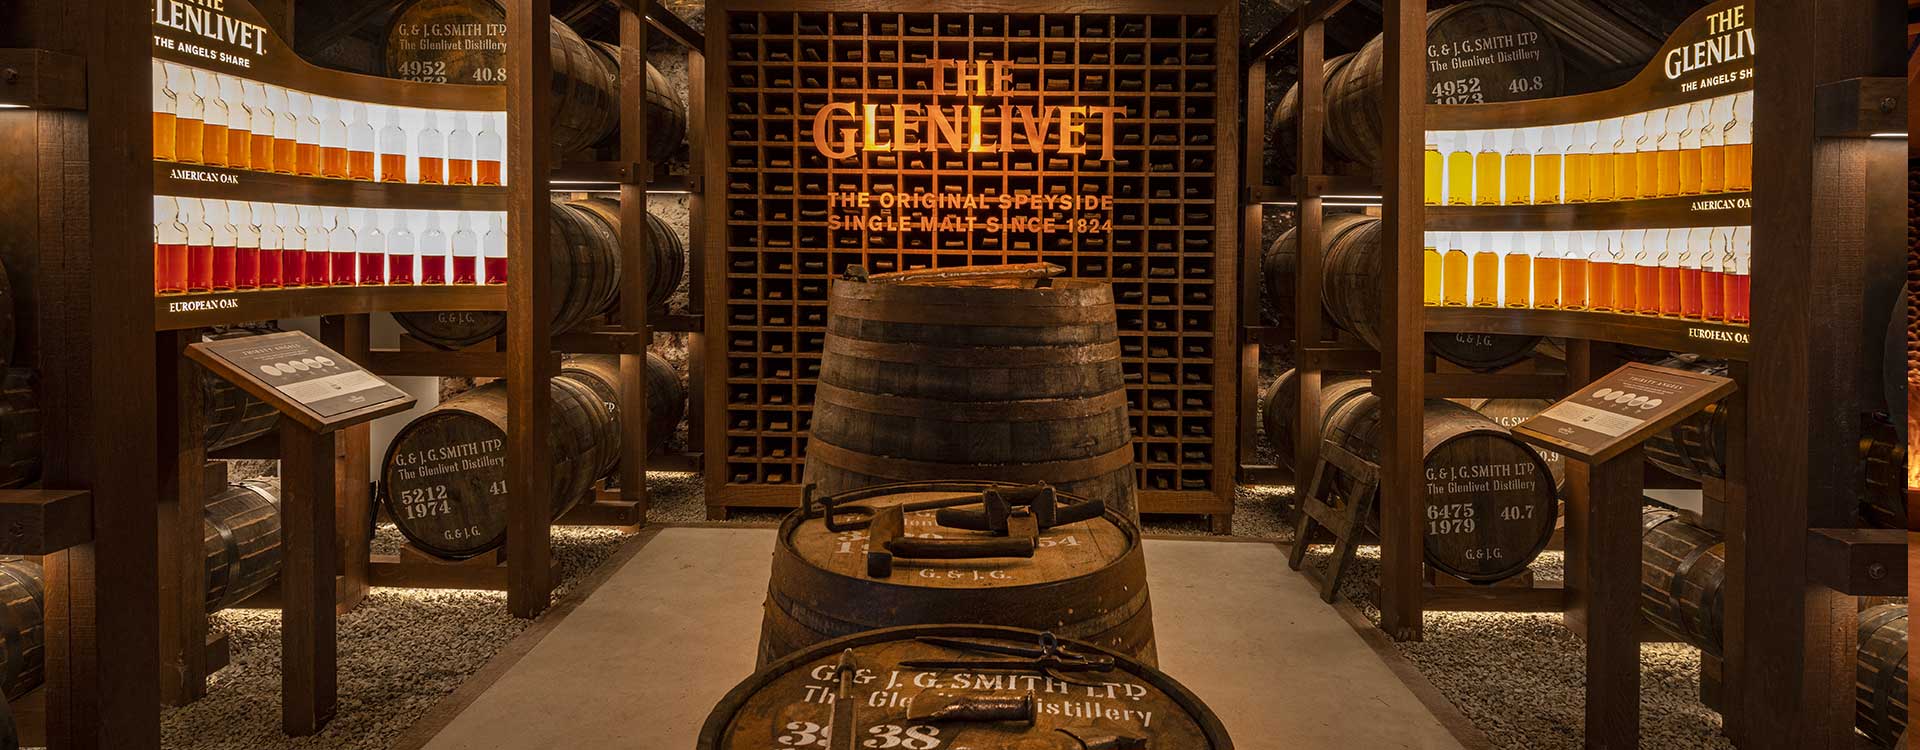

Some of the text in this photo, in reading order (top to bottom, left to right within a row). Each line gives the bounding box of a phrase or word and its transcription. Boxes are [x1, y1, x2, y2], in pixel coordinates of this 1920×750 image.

[1706, 5, 1744, 35] THE
[411, 24, 419, 35] &
[444, 24, 481, 36] SMITH
[154, 36, 174, 50] THE
[220, 53, 250, 68] SHARE
[399, 39, 507, 53] The Glenlivet Distillery
[1441, 44, 1450, 55] &
[1475, 35, 1513, 51] SMITH
[1430, 49, 1540, 72] The Glenlivet Distillery
[1665, 28, 1755, 80] GLENLIV
[398, 61, 446, 76] 4952
[472, 67, 507, 82] 40.8
[925, 59, 1014, 97] THE
[1509, 76, 1543, 93] 40.8
[1681, 81, 1697, 92] THE
[1432, 77, 1481, 98] 4952
[813, 101, 1127, 161] GLENLIVET
[170, 169, 239, 184] AMERICAN OAK
[828, 192, 1113, 211] THE ORIGINAL SPEYSIDE
[1691, 198, 1752, 211] AMERICAN OA
[828, 215, 1112, 234] SINGLE MALT SINCE 1824
[170, 299, 238, 312] EUROPEAN OAK
[1689, 328, 1749, 344] EUROPEAN OA
[408, 452, 417, 463] &
[439, 442, 478, 460] SMITH
[1539, 450, 1559, 462] 0.9
[398, 456, 505, 480] The Glenlivet Distillery
[1439, 467, 1447, 478] &
[1472, 464, 1510, 478] SMITH
[401, 485, 448, 505] 5212
[1427, 479, 1535, 495] The Glenlivet Distillery
[405, 500, 451, 520] 1974
[1427, 503, 1474, 520] 6475
[1501, 505, 1534, 520] 40.7
[455, 530, 462, 538] &
[1429, 518, 1476, 535] 1979
[1476, 550, 1483, 559] &
[947, 570, 962, 579] &
[853, 668, 877, 684] &
[950, 673, 1069, 694] SMITH
[804, 685, 836, 704] Th
[1036, 698, 1152, 727] istillery
